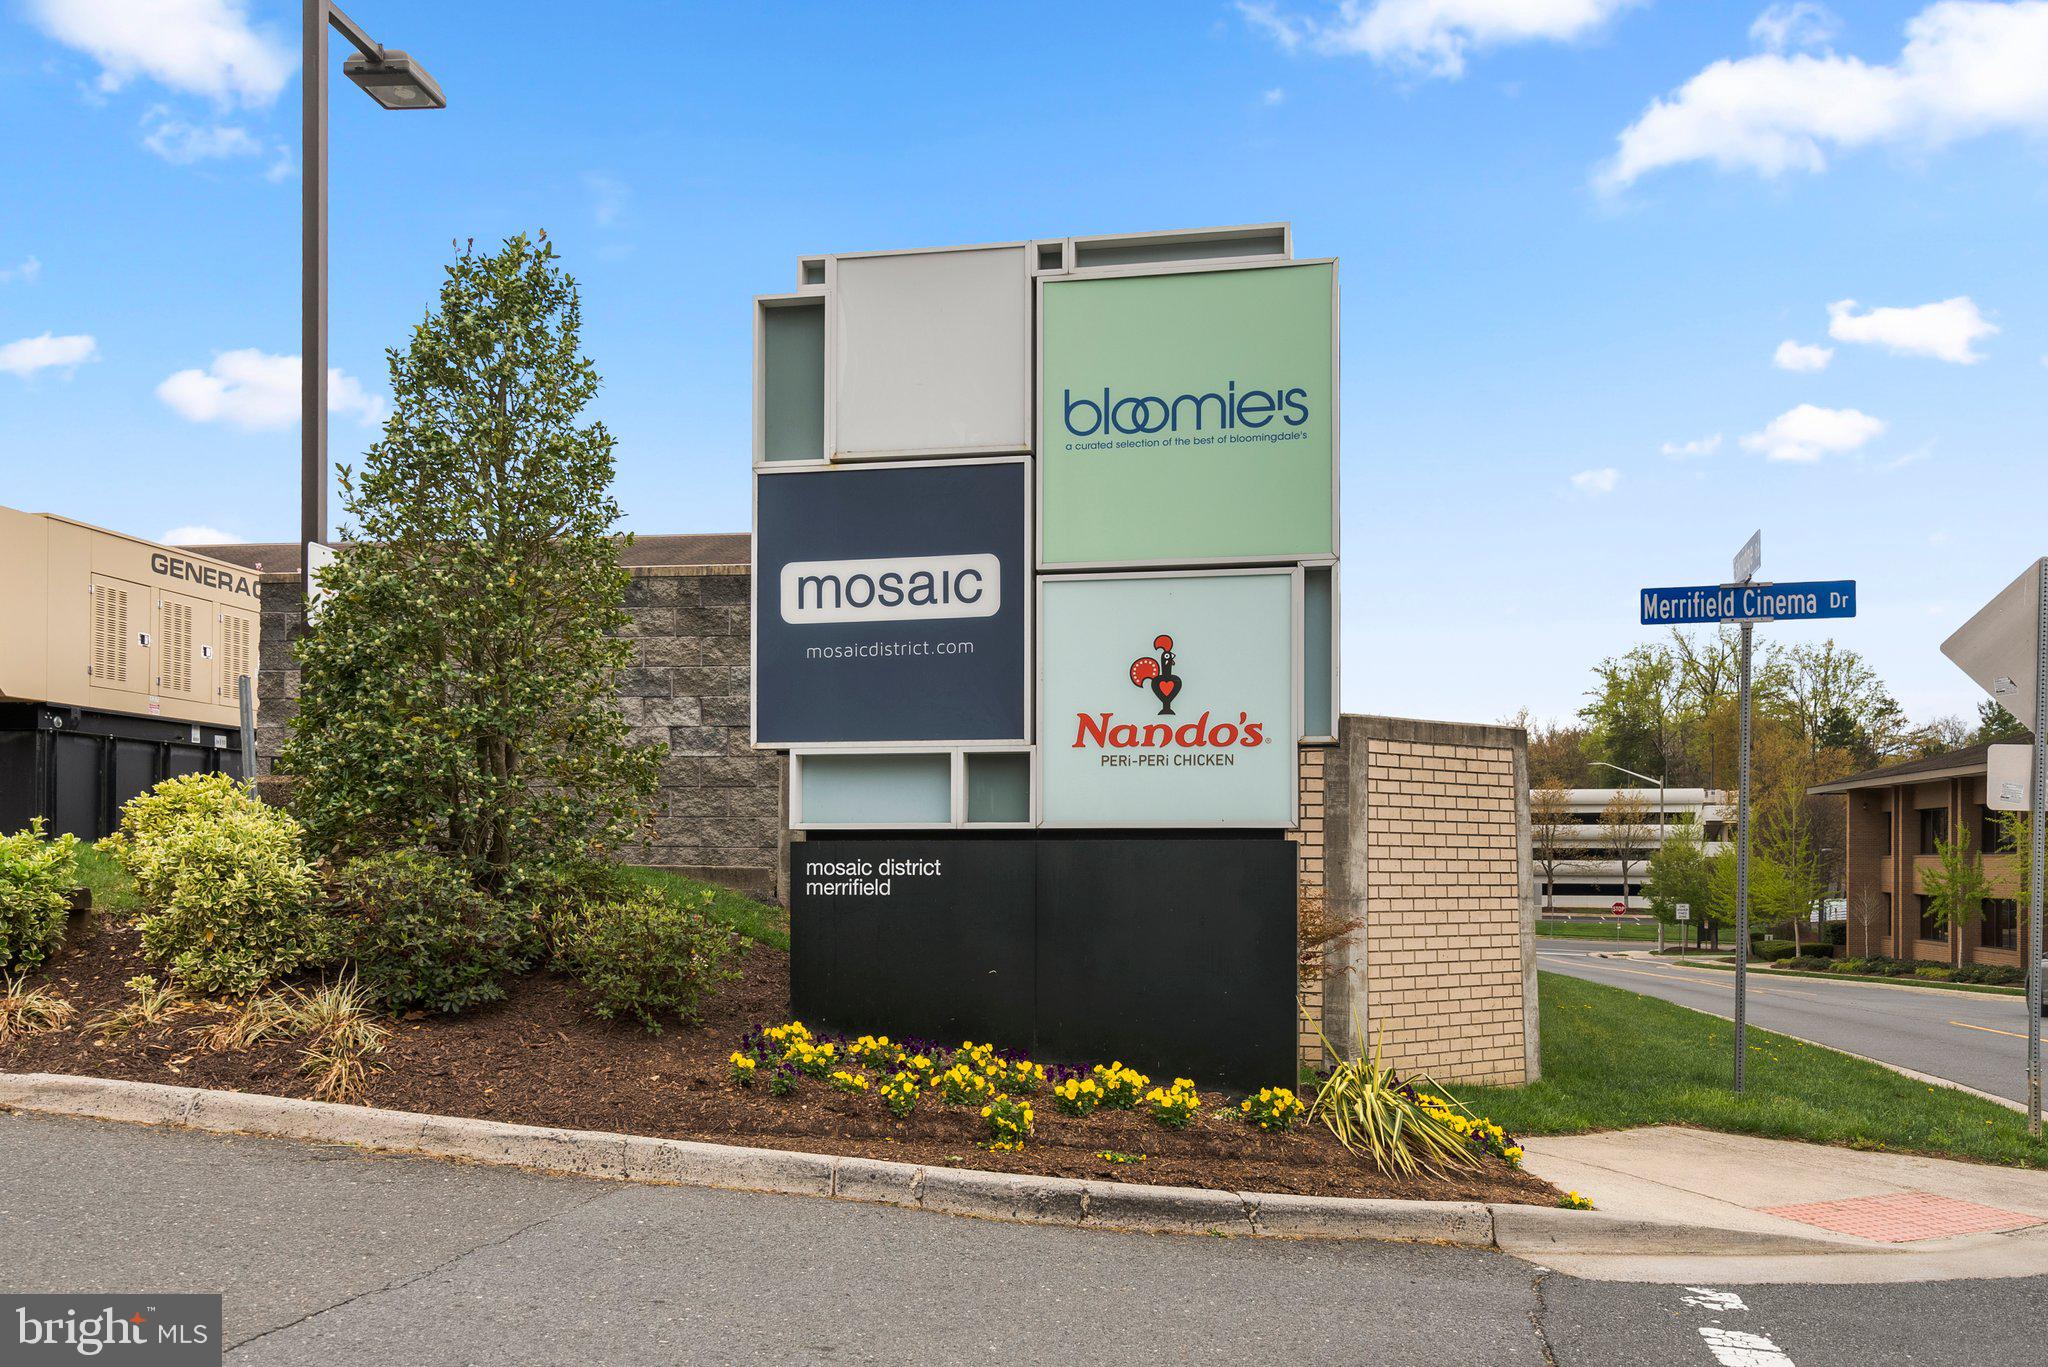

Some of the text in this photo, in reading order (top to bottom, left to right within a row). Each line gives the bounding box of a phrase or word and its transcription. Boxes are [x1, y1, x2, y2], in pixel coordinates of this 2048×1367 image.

[1064, 380, 1309, 436] bloomie's
[1065, 430, 1308, 451] a curated selection of the best of bloomingdale's
[797, 568, 983, 610] mosaic
[1643, 589, 1849, 620] Merrifield Cinema Dr
[806, 641, 974, 659] mosaicdistrict.com
[1072, 711, 1264, 748] Nando's
[1173, 753, 1235, 767] CHICKEN
[806, 858, 942, 876] mosaic district
[806, 878, 891, 896] merrifield
